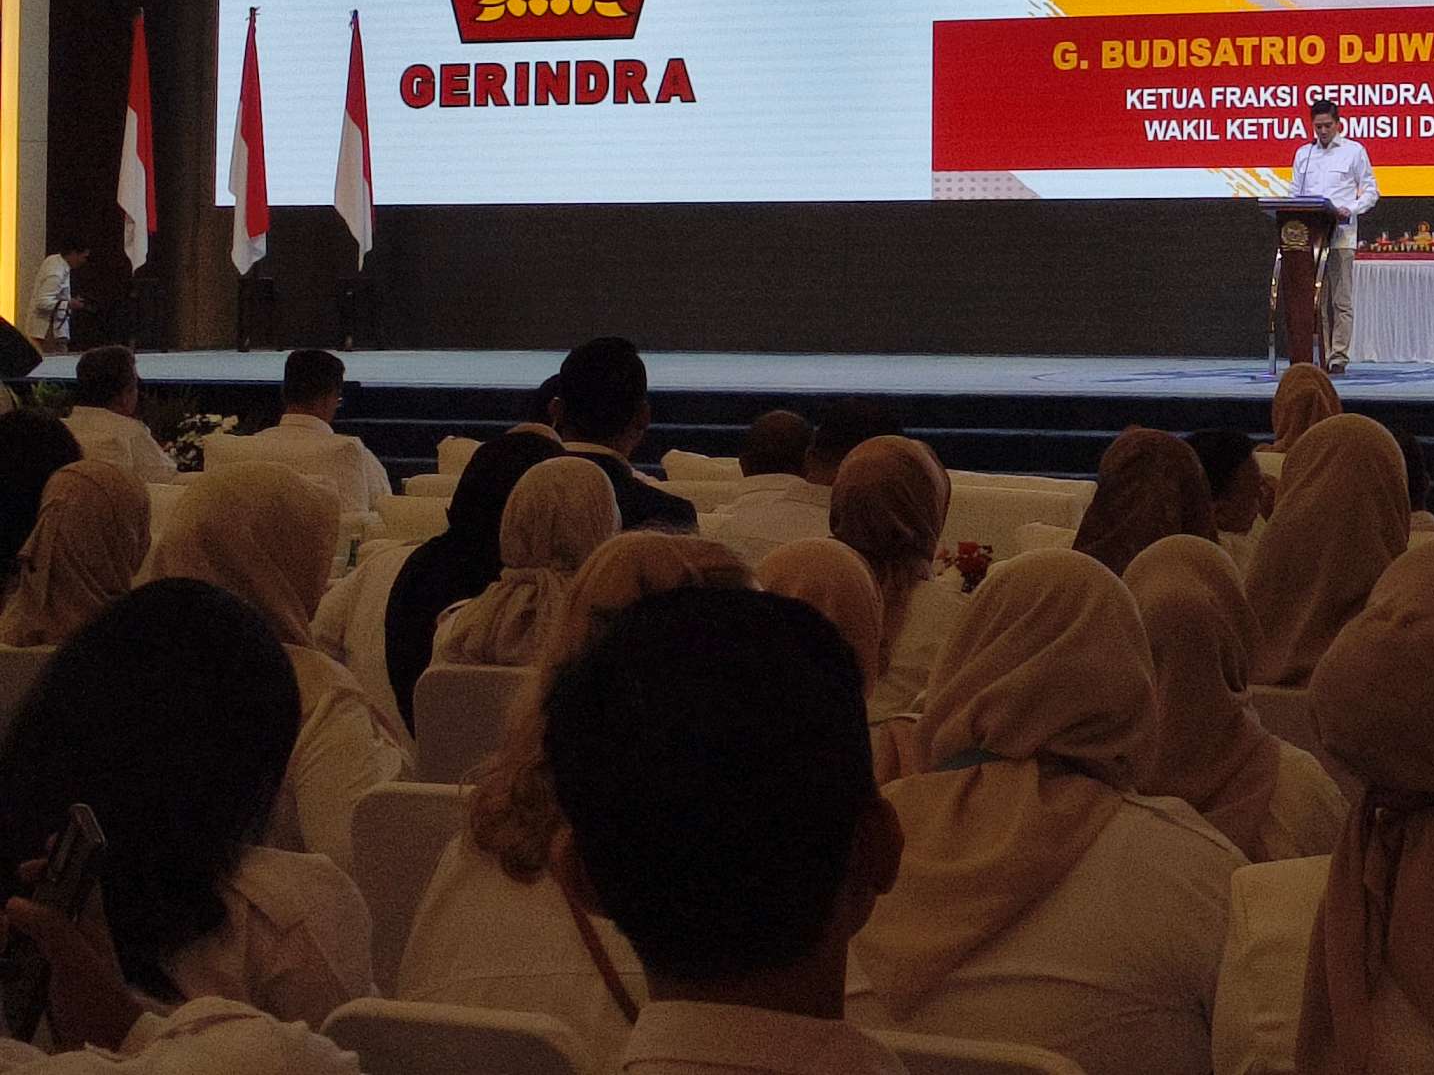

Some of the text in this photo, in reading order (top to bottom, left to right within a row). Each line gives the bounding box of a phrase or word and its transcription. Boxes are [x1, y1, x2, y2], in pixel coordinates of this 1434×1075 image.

[1052, 41, 1089, 71] G.
[1101, 34, 1326, 70] BUDISATRIO
[399, 57, 697, 109] GERINDRA
[1126, 88, 1205, 110] KETUA
[1211, 86, 1298, 108] FRAKSI
[1144, 119, 1220, 141] WAKIL
[1226, 118, 1307, 140] KETUA
[1314, 115, 1398, 139] OMISI
[1405, 115, 1412, 138] I
